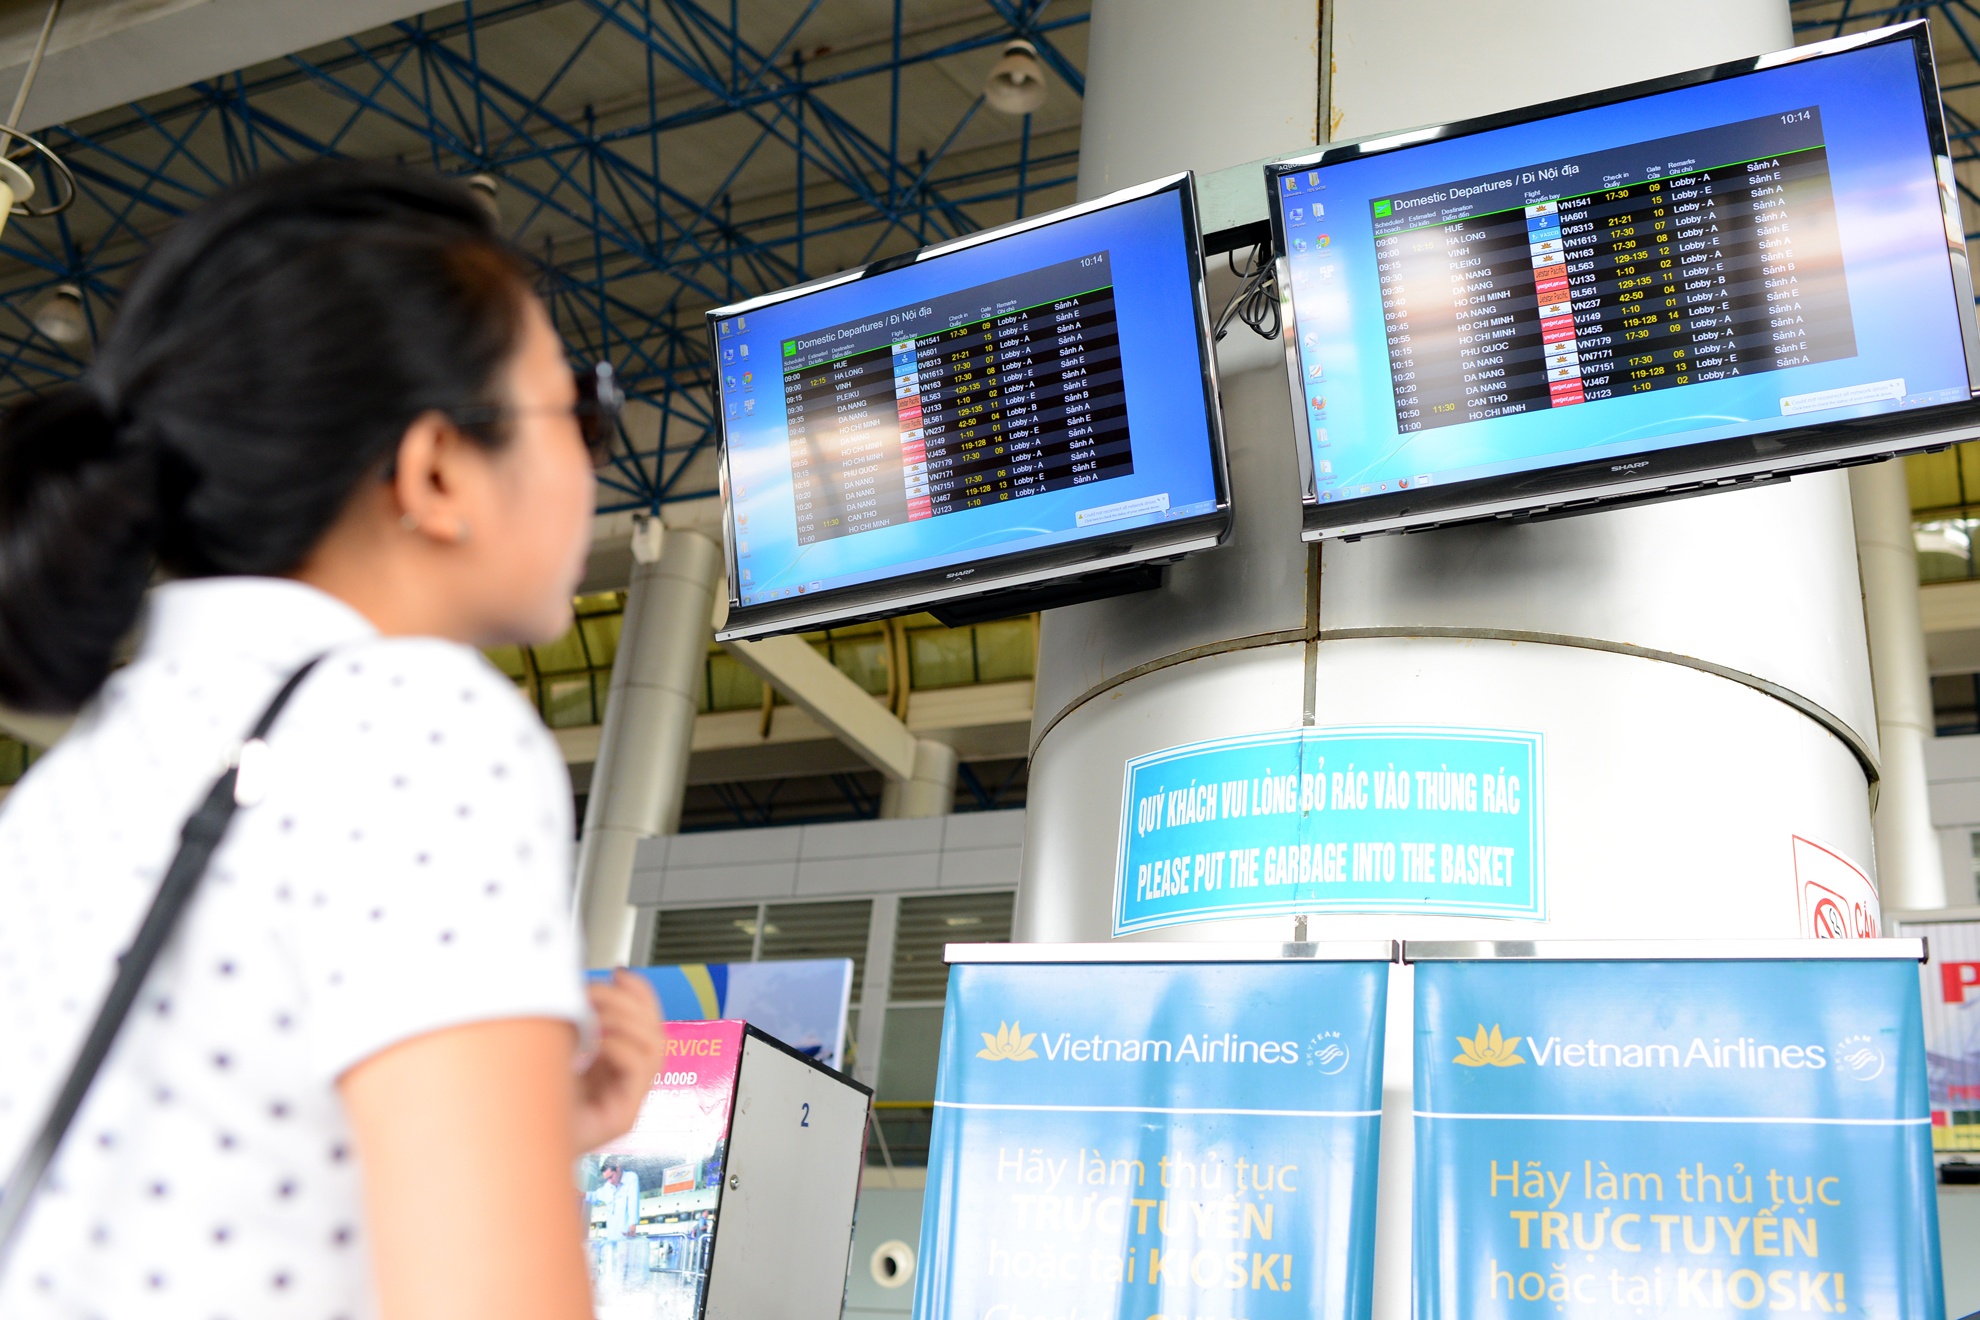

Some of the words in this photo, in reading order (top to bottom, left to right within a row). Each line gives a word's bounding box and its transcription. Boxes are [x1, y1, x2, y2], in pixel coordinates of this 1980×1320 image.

[1780, 110, 1811, 125] 10:14
[1374, 217, 1404, 229] Scheduled
[1441, 203, 1473, 215] Destination
[1524, 189, 1541, 199] Flight
[1602, 172, 1623, 182] Check
[1667, 157, 1696, 169] Remarks
[1393, 190, 1447, 210] Domestic
[1449, 176, 1513, 201] Departures
[1521, 171, 1536, 184] Đi
[1537, 166, 1559, 183] Nội
[1560, 162, 1580, 178] địa
[1444, 223, 1464, 233] HUE
[1558, 197, 1591, 210] VN1541
[1604, 189, 1629, 201] 17-30
[1445, 236, 1459, 246] HA
[1460, 231, 1486, 243] LONG
[1559, 210, 1588, 223] HA601
[1447, 247, 1470, 258] VINH
[1607, 215, 1632, 226] 21-21
[1448, 257, 1481, 270] PLEIKU
[1563, 234, 1597, 248] VN1613
[1609, 227, 1634, 239] 17-30
[1080, 254, 1103, 268] 10:14
[1450, 273, 1463, 283] DA
[1465, 268, 1492, 280] NANG
[1564, 248, 1594, 260] VN163
[1611, 240, 1636, 251] 17-30
[1452, 286, 1465, 295] DA
[1466, 280, 1493, 292] NANG
[1566, 261, 1594, 273] BL563
[1613, 250, 1648, 264] 129-135
[1454, 298, 1468, 307] HO
[1469, 295, 1485, 304] CHI
[1487, 290, 1511, 301] MINH
[1568, 274, 1596, 286] VJ133
[1614, 266, 1635, 277] 1-10
[1455, 311, 1468, 320] DA
[1470, 305, 1496, 317] NANG
[1569, 286, 1597, 298] BL561
[1616, 276, 1652, 289] 129-135
[797, 331, 835, 350] Domestic
[837, 318, 883, 341] Departures
[889, 313, 900, 325] Đi
[901, 308, 916, 324] Nội
[918, 304, 932, 319] địa
[1457, 323, 1471, 332] HO
[1472, 320, 1488, 329] CHI
[1490, 315, 1514, 326] MINH
[1571, 299, 1601, 311] VN237
[1618, 291, 1643, 302] 42-50
[1458, 335, 1473, 345] HO
[1474, 332, 1490, 342] CHI
[1491, 327, 1515, 339] MINH
[1573, 312, 1601, 323] VJ149
[1620, 304, 1640, 315] 1-10
[915, 335, 939, 348] VN1541
[916, 347, 937, 359] HA601
[1460, 347, 1480, 357] PHU
[1481, 342, 1509, 353] QUOC
[1575, 324, 1603, 336] VJ455
[1621, 314, 1657, 328] 119-128
[1462, 361, 1475, 370] DA
[1476, 355, 1503, 367] NANG
[1576, 336, 1611, 349] VN7179
[1623, 329, 1648, 340] 17-30
[918, 368, 944, 381] VN1613
[1463, 373, 1476, 382] DA
[1478, 368, 1505, 380] NANG
[1578, 349, 1613, 362] VN7171
[1465, 386, 1478, 395] DA
[1479, 381, 1506, 392] NANG
[1580, 361, 1614, 374] VN7151
[1627, 355, 1652, 366] 17-30
[919, 380, 941, 392] VN163
[921, 392, 941, 403] BL563
[1466, 397, 1488, 407] CAN
[1489, 393, 1508, 403] THO
[1581, 375, 1610, 387] VJ467
[1628, 366, 1664, 379] 119-128
[1468, 411, 1482, 420] HO
[1484, 408, 1500, 417] CHI
[1501, 403, 1525, 414] MINH
[1583, 388, 1611, 400] VJ123
[1630, 381, 1651, 392] 1-10
[922, 403, 942, 414] VJ133
[923, 414, 943, 425] BL561
[924, 425, 945, 436] VN237
[925, 437, 945, 447] VJ149
[926, 448, 946, 459] VJ455
[927, 458, 953, 470] VN7179
[1611, 461, 1649, 472] SHARP
[928, 469, 953, 481] VN7171
[929, 481, 954, 492] VN7151
[930, 493, 951, 503] VJ467
[931, 504, 952, 515] VJ123
[945, 568, 975, 579] SHARP
[1137, 786, 1164, 838] QUÝ
[1167, 778, 1216, 827] KHÁCH
[1222, 780, 1247, 820] VUI
[1252, 767, 1298, 814] LÒNG
[1302, 757, 1326, 811] BỎ
[1331, 762, 1368, 810] RÁC
[1373, 762, 1410, 810] VÀO
[1415, 762, 1477, 812] THÙNG
[1482, 766, 1520, 814] RÁC
[1137, 856, 1189, 902] PLEASE
[1194, 850, 1224, 892] PUT
[1229, 848, 1259, 888] THE
[1264, 843, 1348, 886] GARBAGE
[1352, 843, 1394, 883] INTO
[1401, 843, 1436, 884] THE
[1441, 846, 1515, 888] BASKET
[659, 1039, 723, 1056] ERVICE
[1041, 1032, 1172, 1064] Vietnam
[1176, 1033, 1299, 1064] Airlines
[1526, 1036, 1678, 1068] Vietnam
[1684, 1037, 1826, 1070] Airlines
[651, 1071, 697, 1086] 0.000Đ
[800, 1102, 810, 1128] 2
[997, 1148, 1067, 1194] Hãy
[1079, 1149, 1145, 1187] làm
[1159, 1151, 1223, 1190] thủ
[1236, 1157, 1297, 1200] tục
[1490, 1160, 1571, 1208] Hãy
[1585, 1160, 1663, 1202] làm
[1677, 1162, 1752, 1205] thủ
[1767, 1168, 1840, 1215] tục
[1132, 1188, 1273, 1240] TUYẾN
[1510, 1207, 1641, 1259] TRỰC
[1651, 1202, 1818, 1258] TUYẾN
[1090, 1247, 1135, 1291] tại
[1148, 1247, 1292, 1292] KIOSK!
[1490, 1260, 1598, 1307] hoặc
[1611, 1266, 1662, 1312] tại
[1676, 1268, 1847, 1313] KIOSK!
